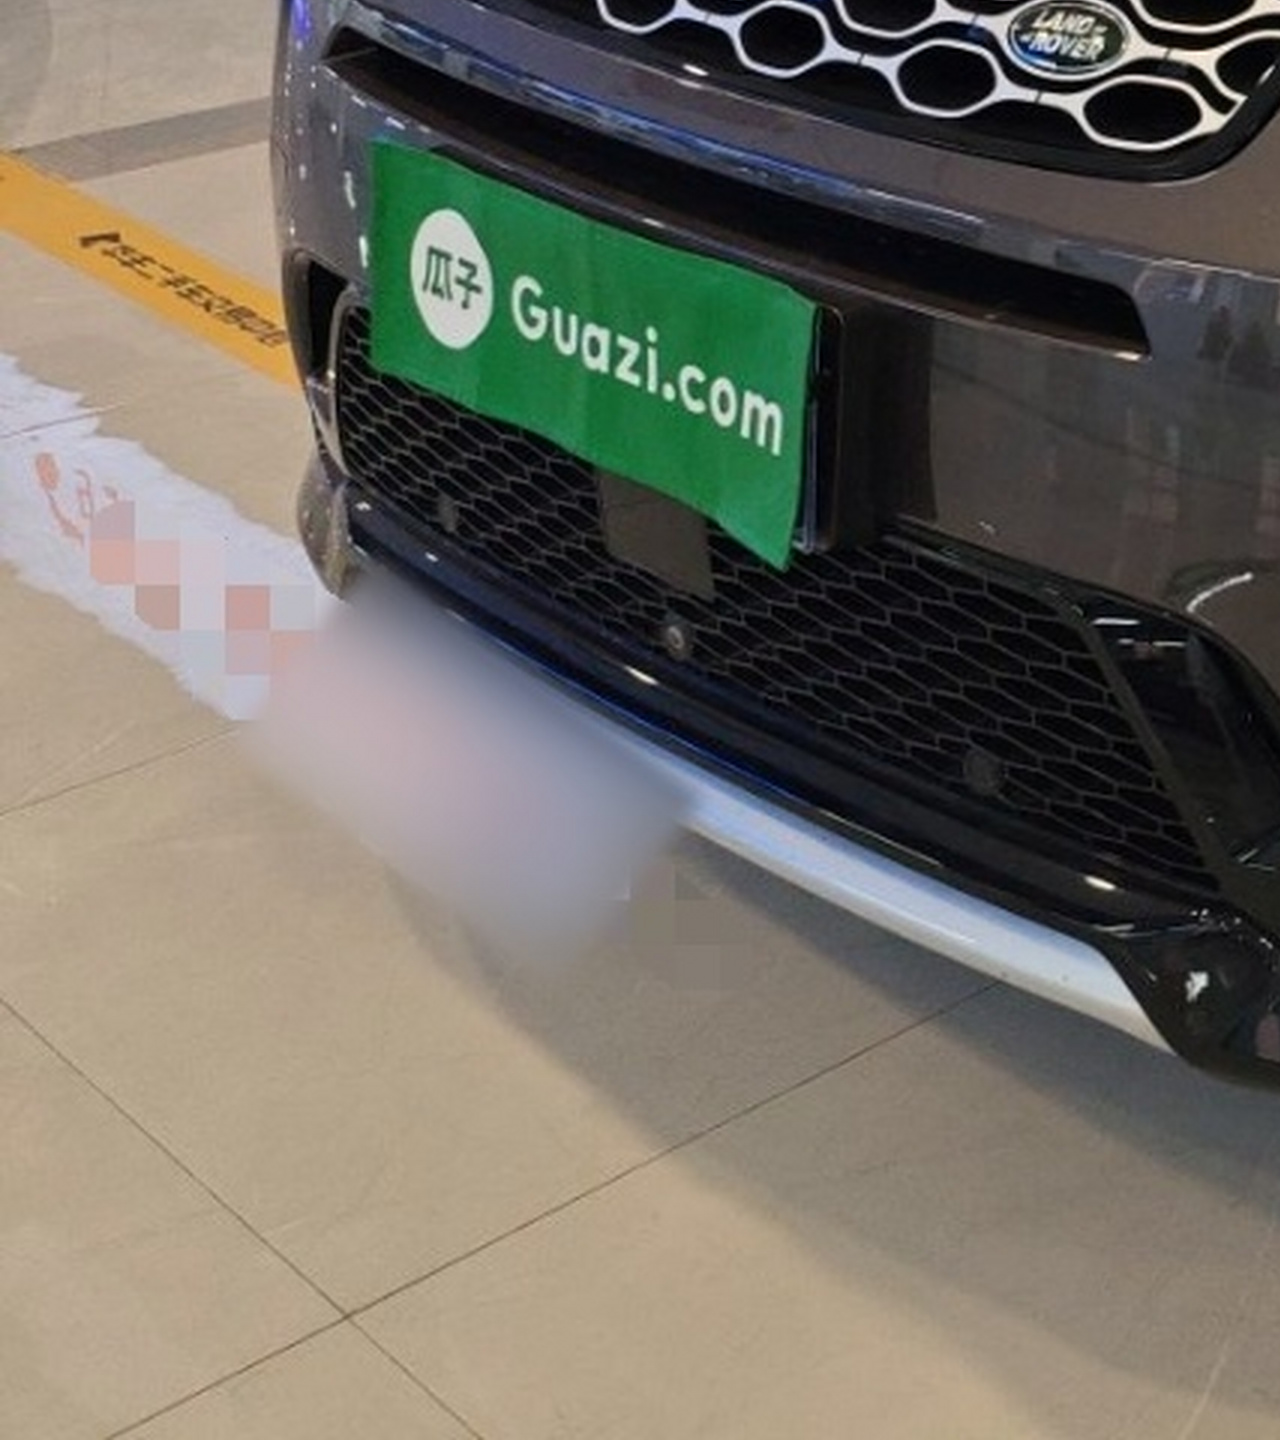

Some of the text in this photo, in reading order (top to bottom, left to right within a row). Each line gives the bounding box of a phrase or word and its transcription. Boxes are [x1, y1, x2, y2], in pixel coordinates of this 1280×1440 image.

[1028, 31, 1106, 60] ROVER
[1033, 11, 1096, 35] LAND
[422, 245, 483, 310] 瓜子
[511, 275, 784, 456] Guazi.com
